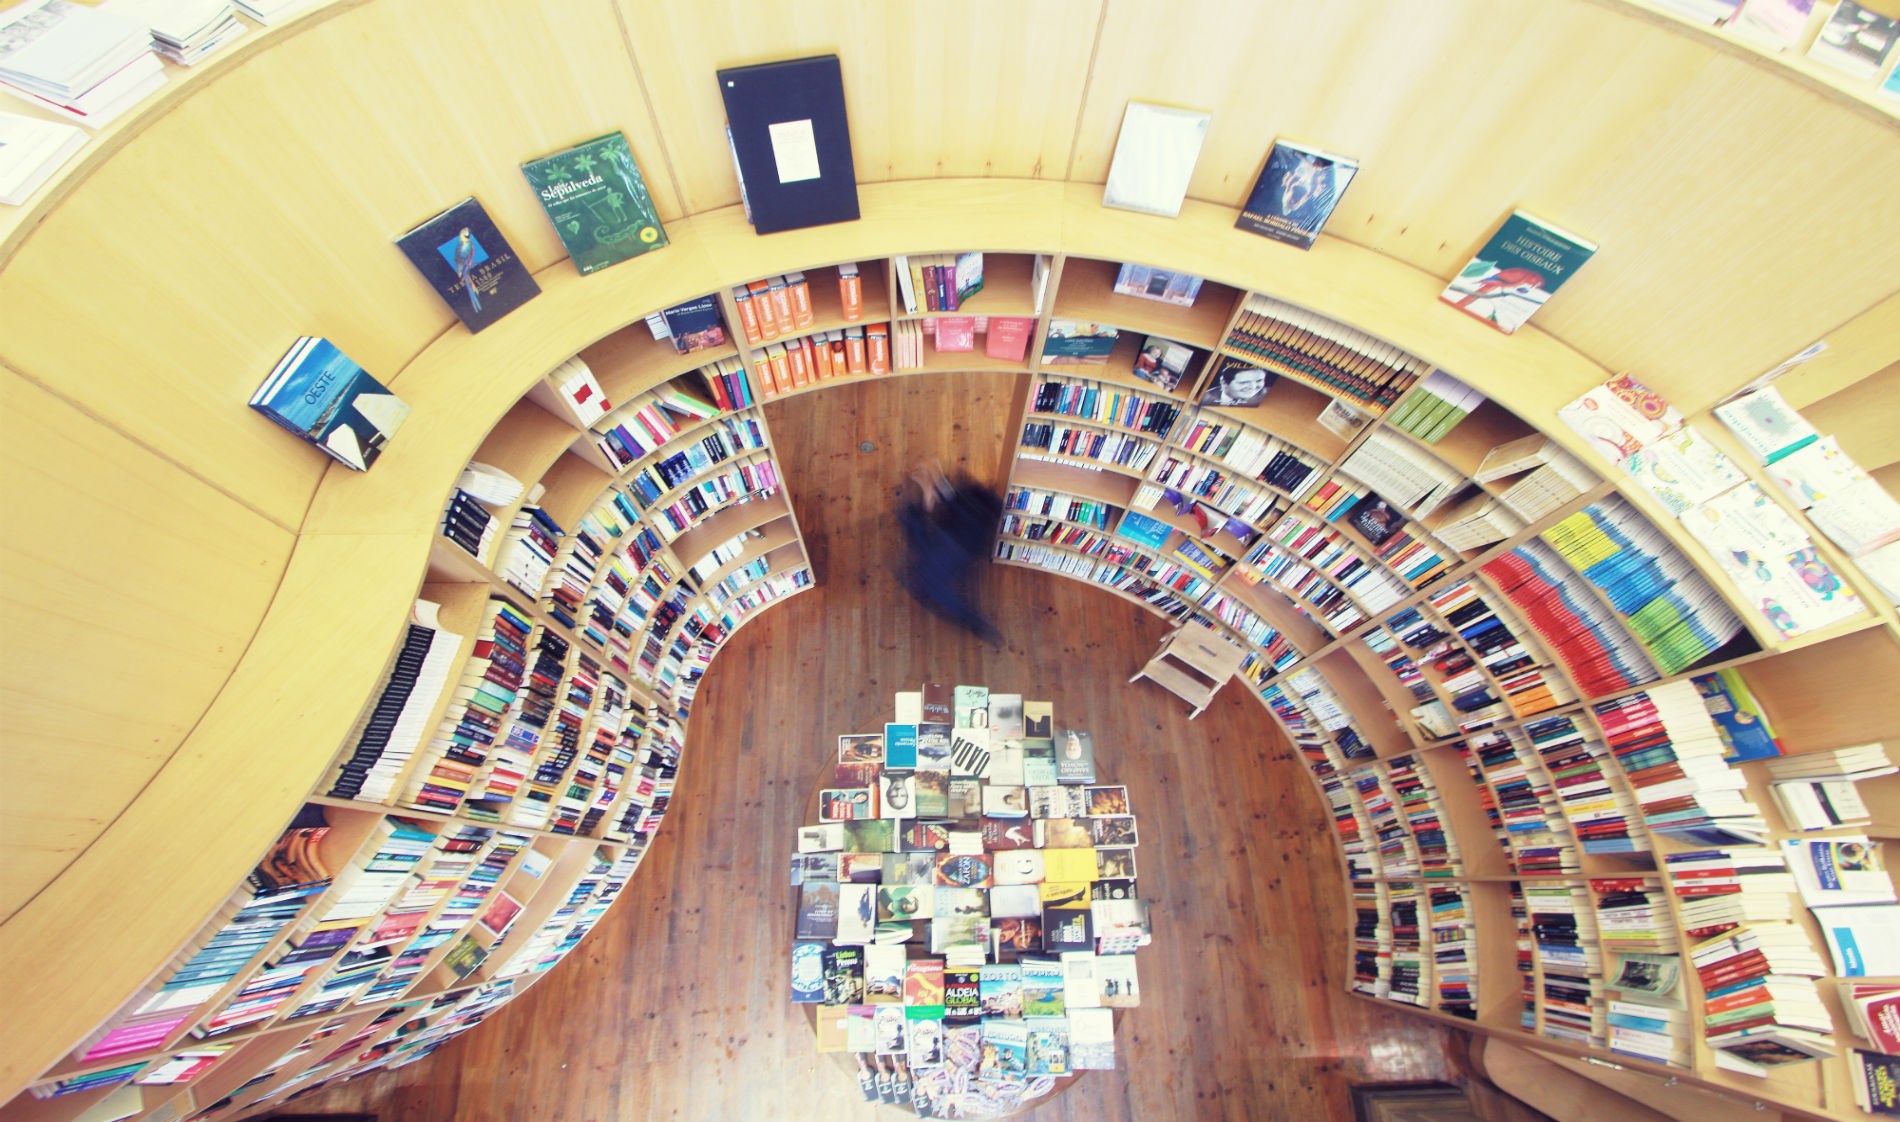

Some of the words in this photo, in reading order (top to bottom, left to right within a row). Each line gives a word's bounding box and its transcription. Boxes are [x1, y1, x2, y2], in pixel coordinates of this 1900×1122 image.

[1516, 235, 1563, 263] HISTOIRE
[1520, 251, 1564, 275] OISEAUX
[448, 274, 478, 294] TERA
[478, 253, 511, 275] BRASIL
[304, 370, 337, 405] OESTE
[945, 987, 979, 998] ALDEIA
